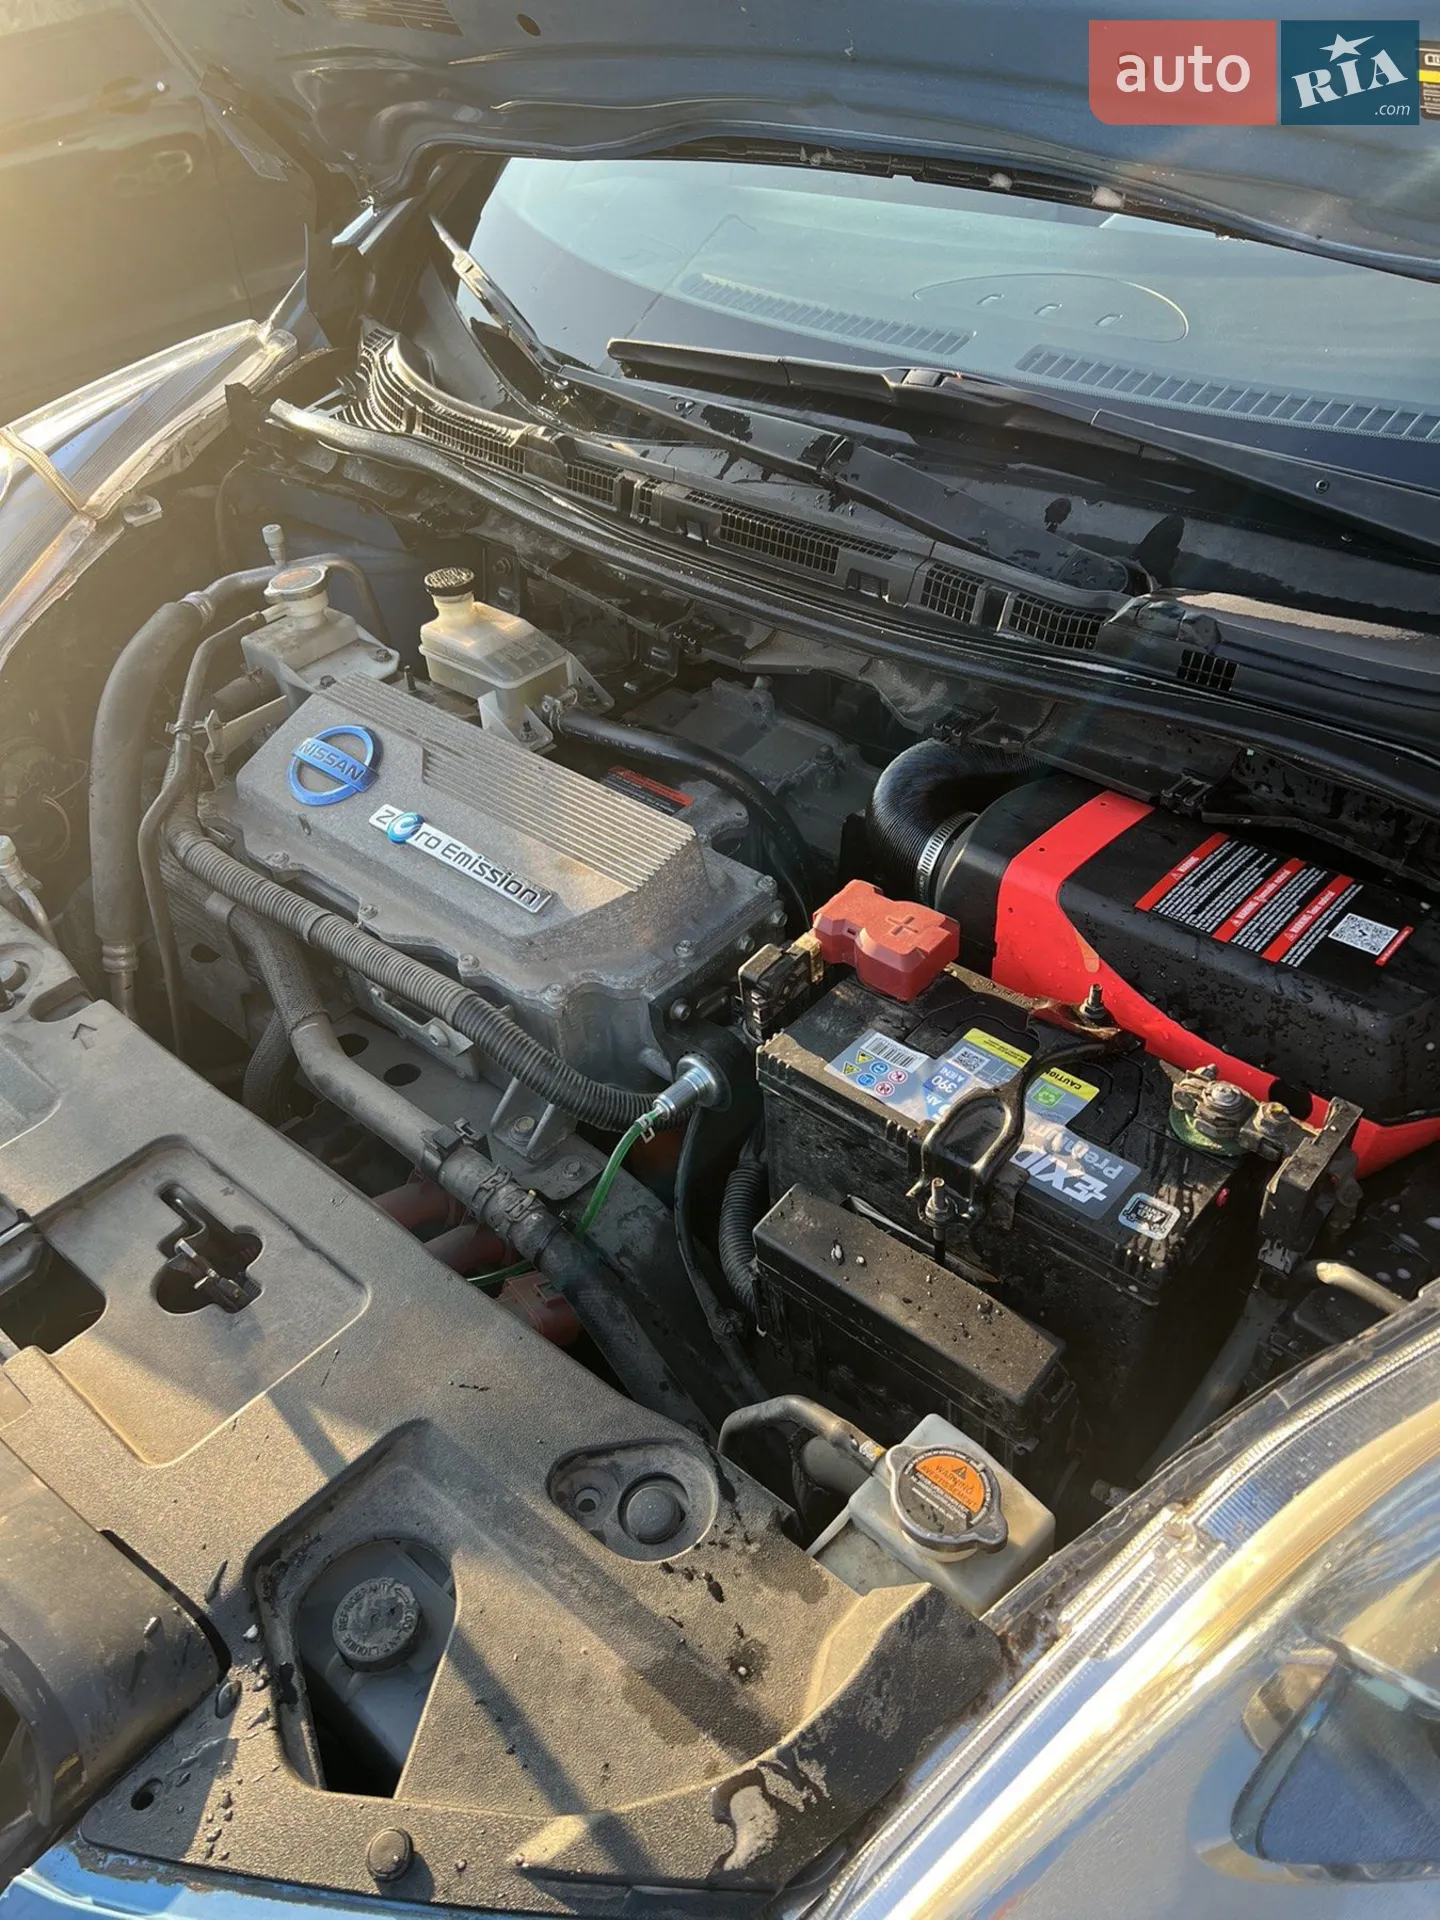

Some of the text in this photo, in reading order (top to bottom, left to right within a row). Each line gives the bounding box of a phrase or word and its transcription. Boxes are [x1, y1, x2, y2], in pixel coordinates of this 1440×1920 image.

[298, 739, 366, 782] NISSAN
[441, 841, 539, 907] Emission
[931, 1075, 958, 1093] 390
[1009, 1150, 1109, 1203] EXID
[921, 1466, 978, 1508] AVERTISSEMENT
[935, 1464, 975, 1495] WARNING
